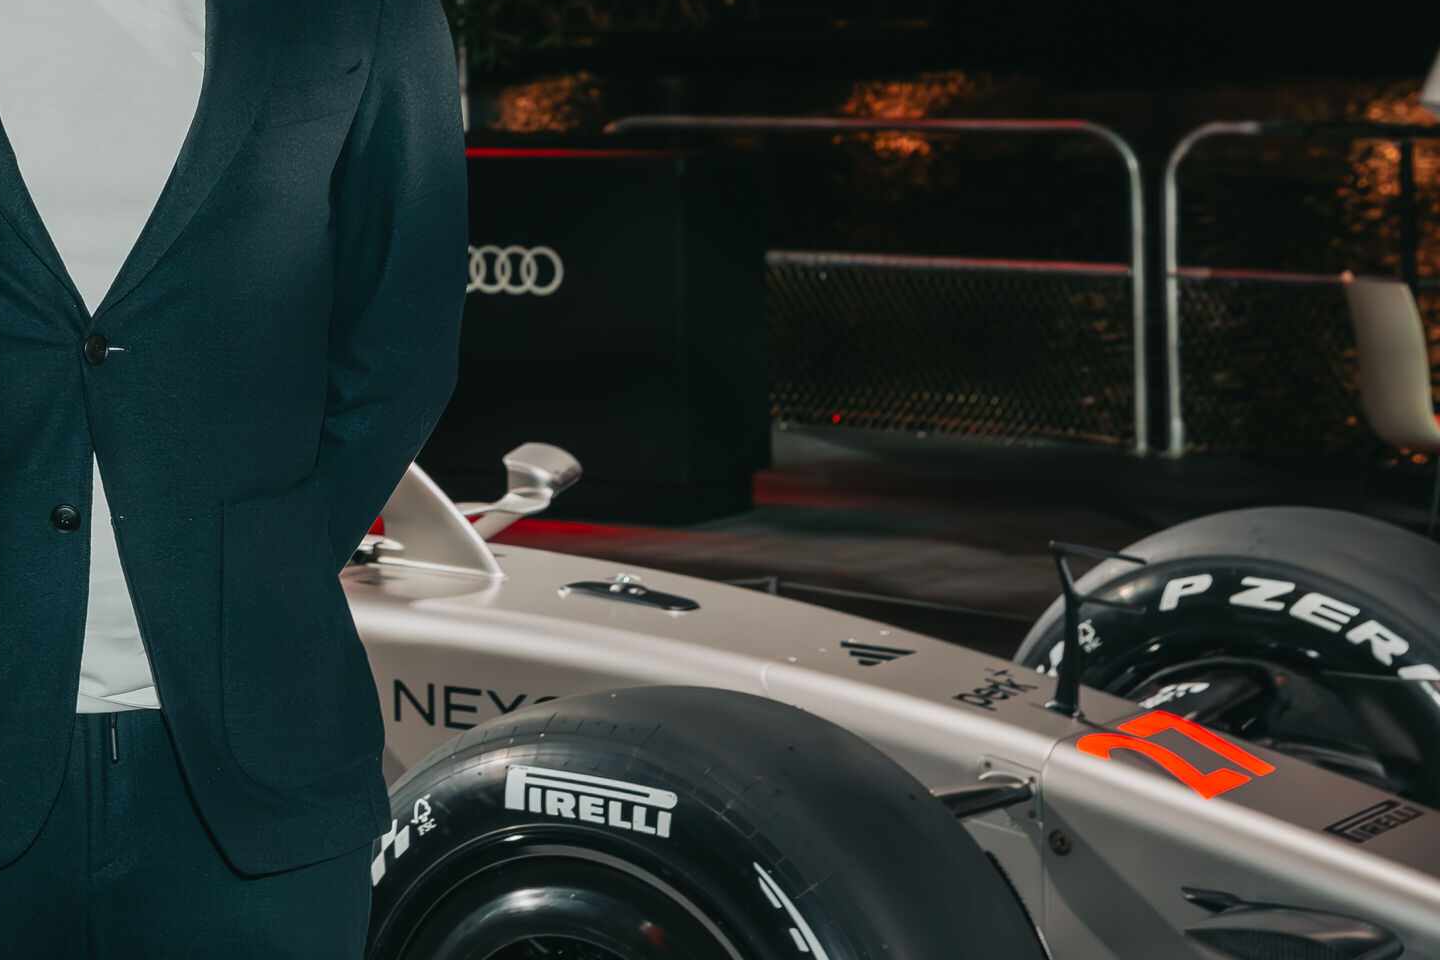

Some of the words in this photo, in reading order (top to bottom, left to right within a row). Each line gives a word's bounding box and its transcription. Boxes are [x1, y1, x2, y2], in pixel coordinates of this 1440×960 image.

[1158, 573, 1213, 612] P
[393, 679, 560, 730] NE
[504, 764, 678, 839] PIRELLI
[1322, 799, 1425, 844] PIRELLI
